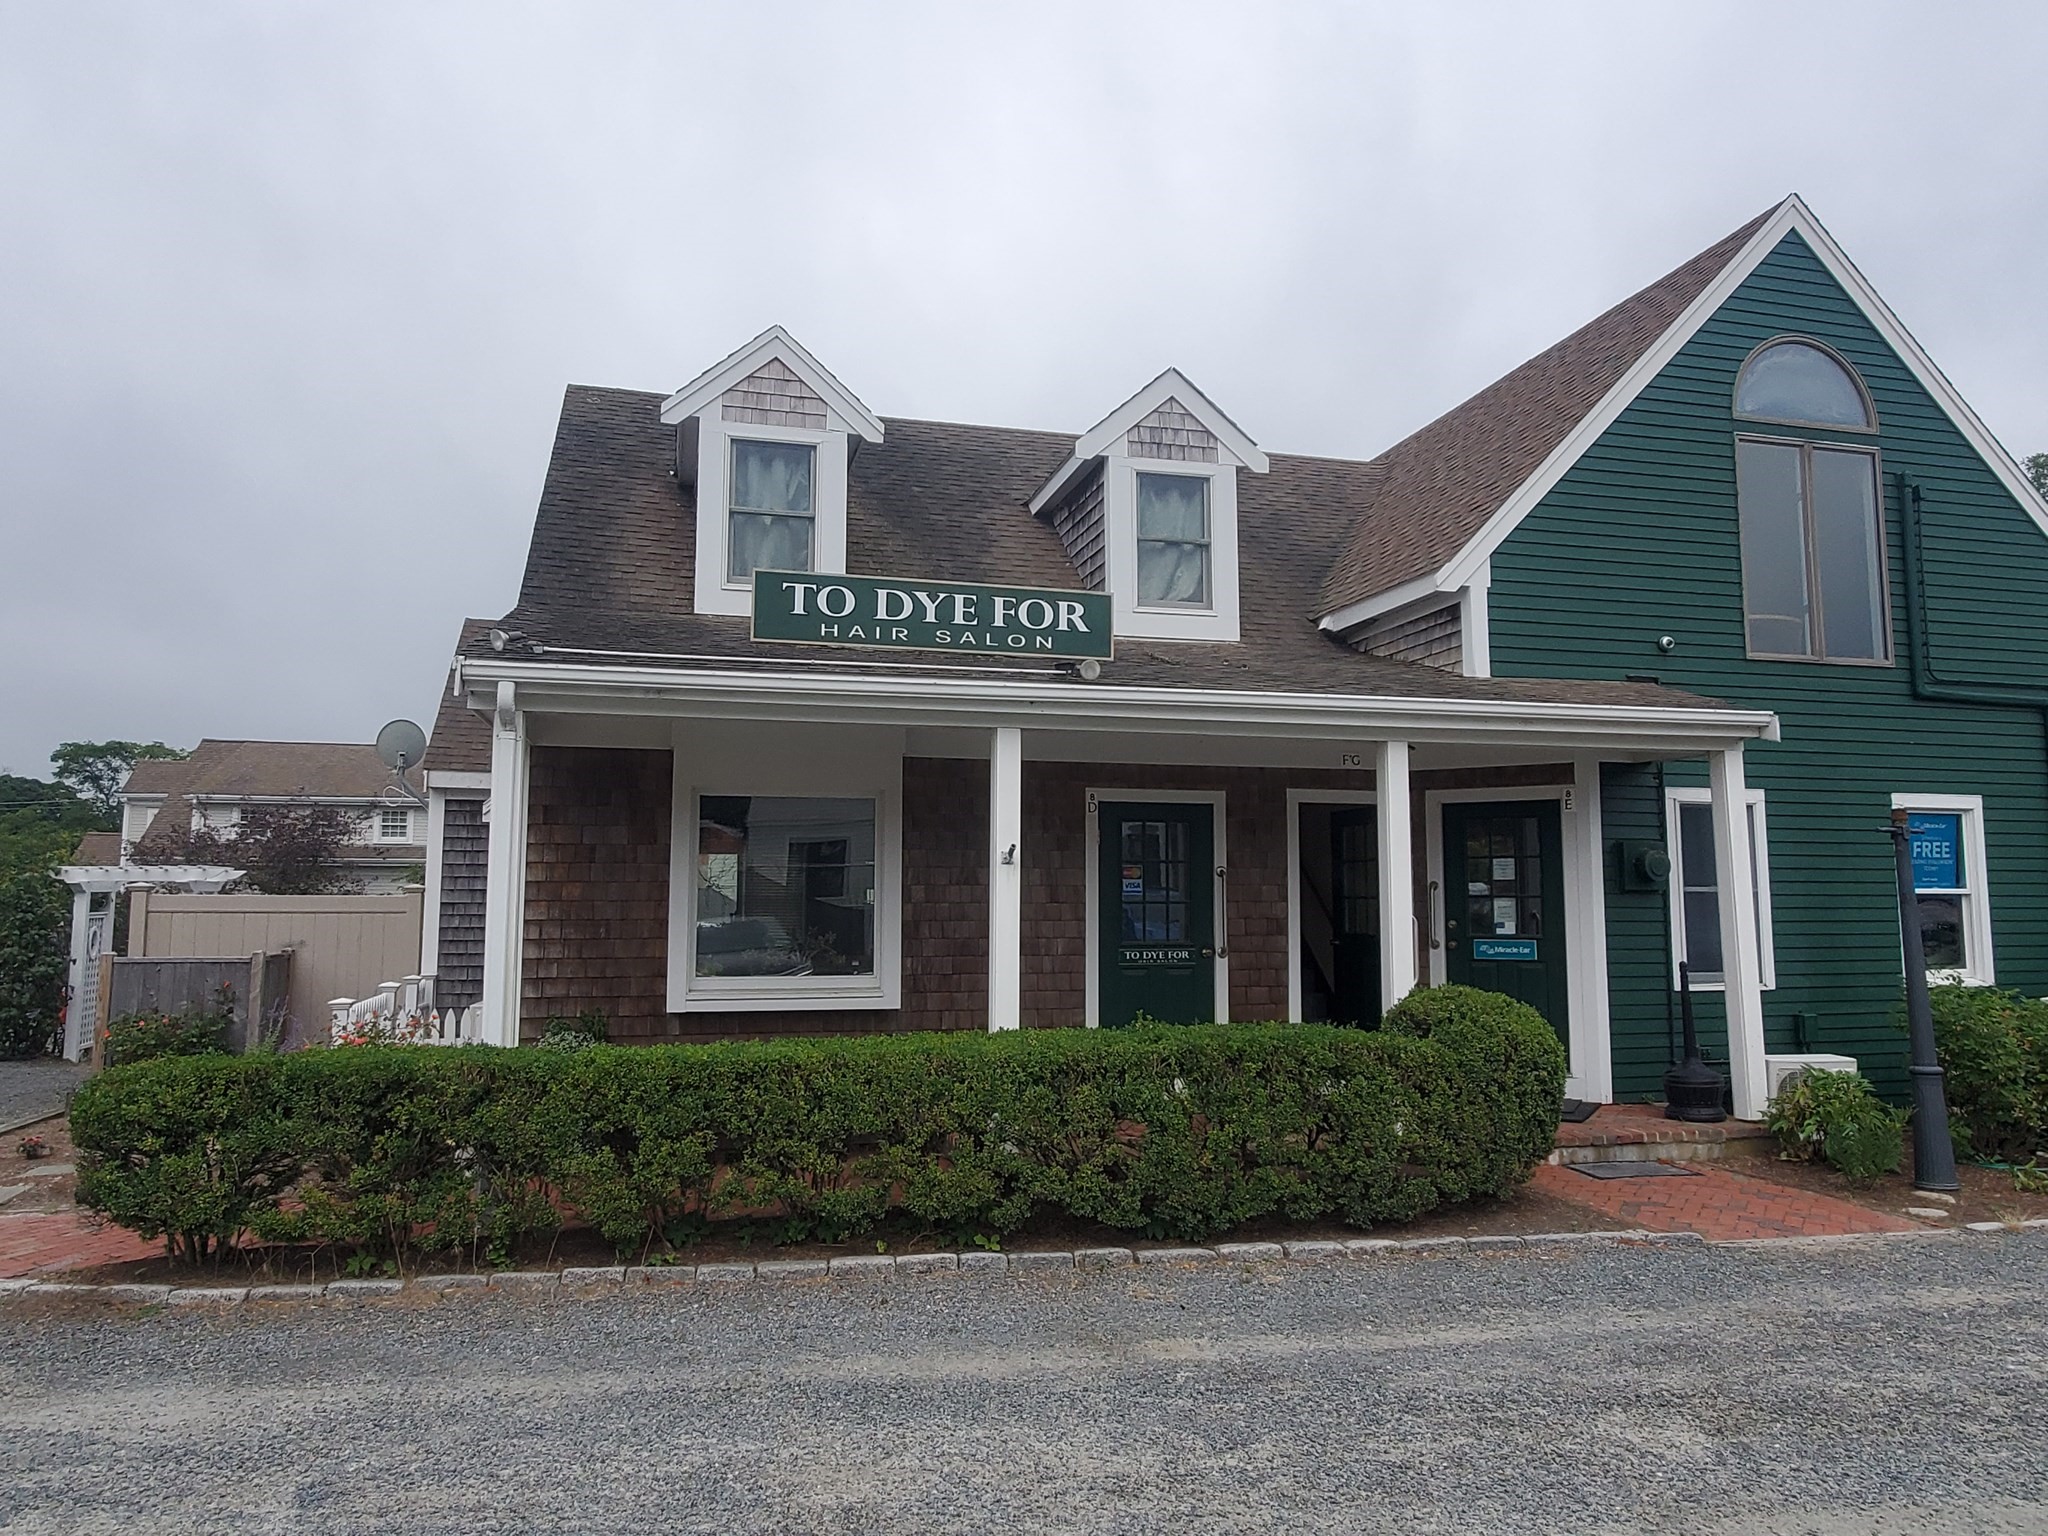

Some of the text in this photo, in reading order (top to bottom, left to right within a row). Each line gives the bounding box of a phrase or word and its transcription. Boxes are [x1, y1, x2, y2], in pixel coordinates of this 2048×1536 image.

[782, 581, 1092, 634] TO DYE FOR
[820, 623, 1053, 650] HAIR SALON
[1089, 792, 1096, 801] 8
[1565, 789, 1571, 798] 8
[1087, 801, 1098, 813] D
[1565, 798, 1572, 810] E
[1913, 841, 1951, 858] FREE
[1124, 950, 1190, 960] TO DYE FOR
